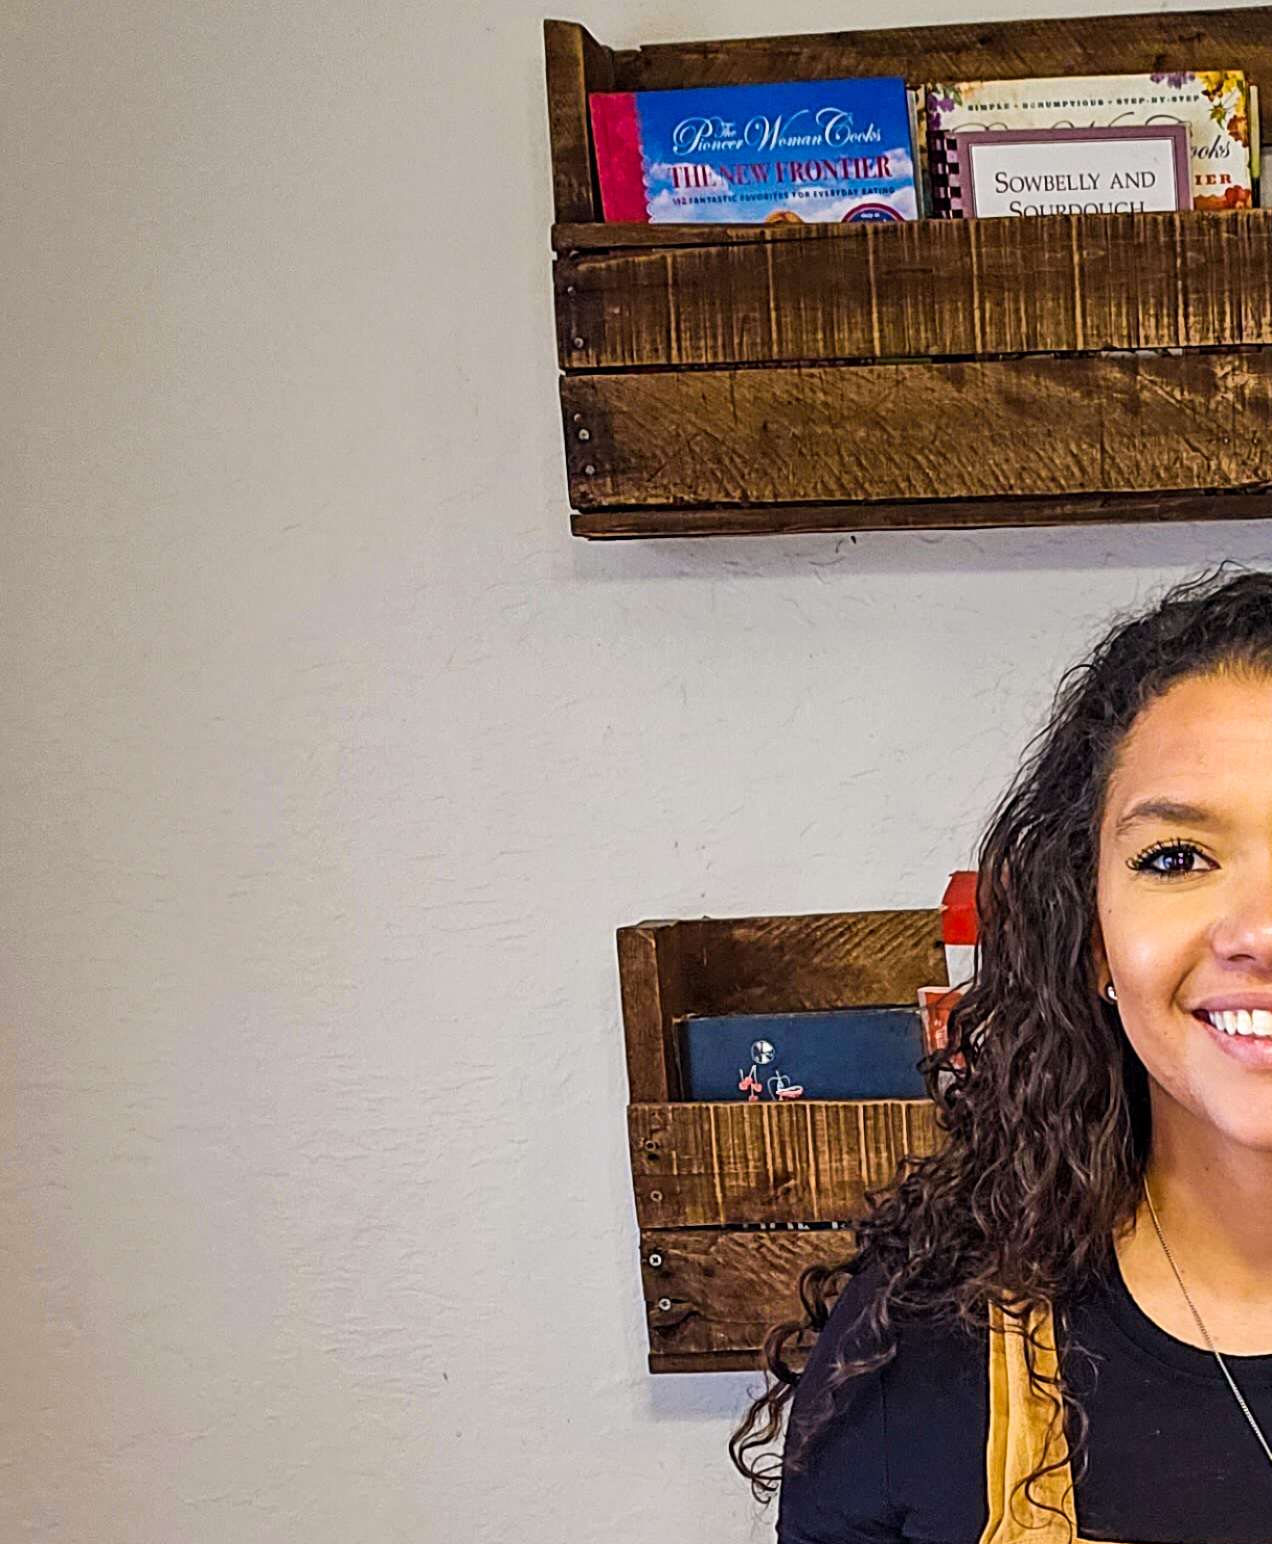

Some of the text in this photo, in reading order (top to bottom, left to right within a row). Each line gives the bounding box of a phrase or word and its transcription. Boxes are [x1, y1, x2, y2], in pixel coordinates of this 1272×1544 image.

[968, 95, 1200, 112] SIMPLE SCRUMPTIOUS STEP-BY-STEP
[673, 107, 882, 156] Pioneer Woman Cooks
[711, 116, 737, 139] The
[671, 155, 893, 189] THE NEW FRONTIER
[1110, 171, 1157, 190] AND
[688, 194, 741, 206] FANTASTIC
[740, 192, 790, 202] FAVORITES
[792, 190, 811, 200] FOR
[813, 188, 859, 198] EVERYDAY
[862, 186, 896, 196] EATING
